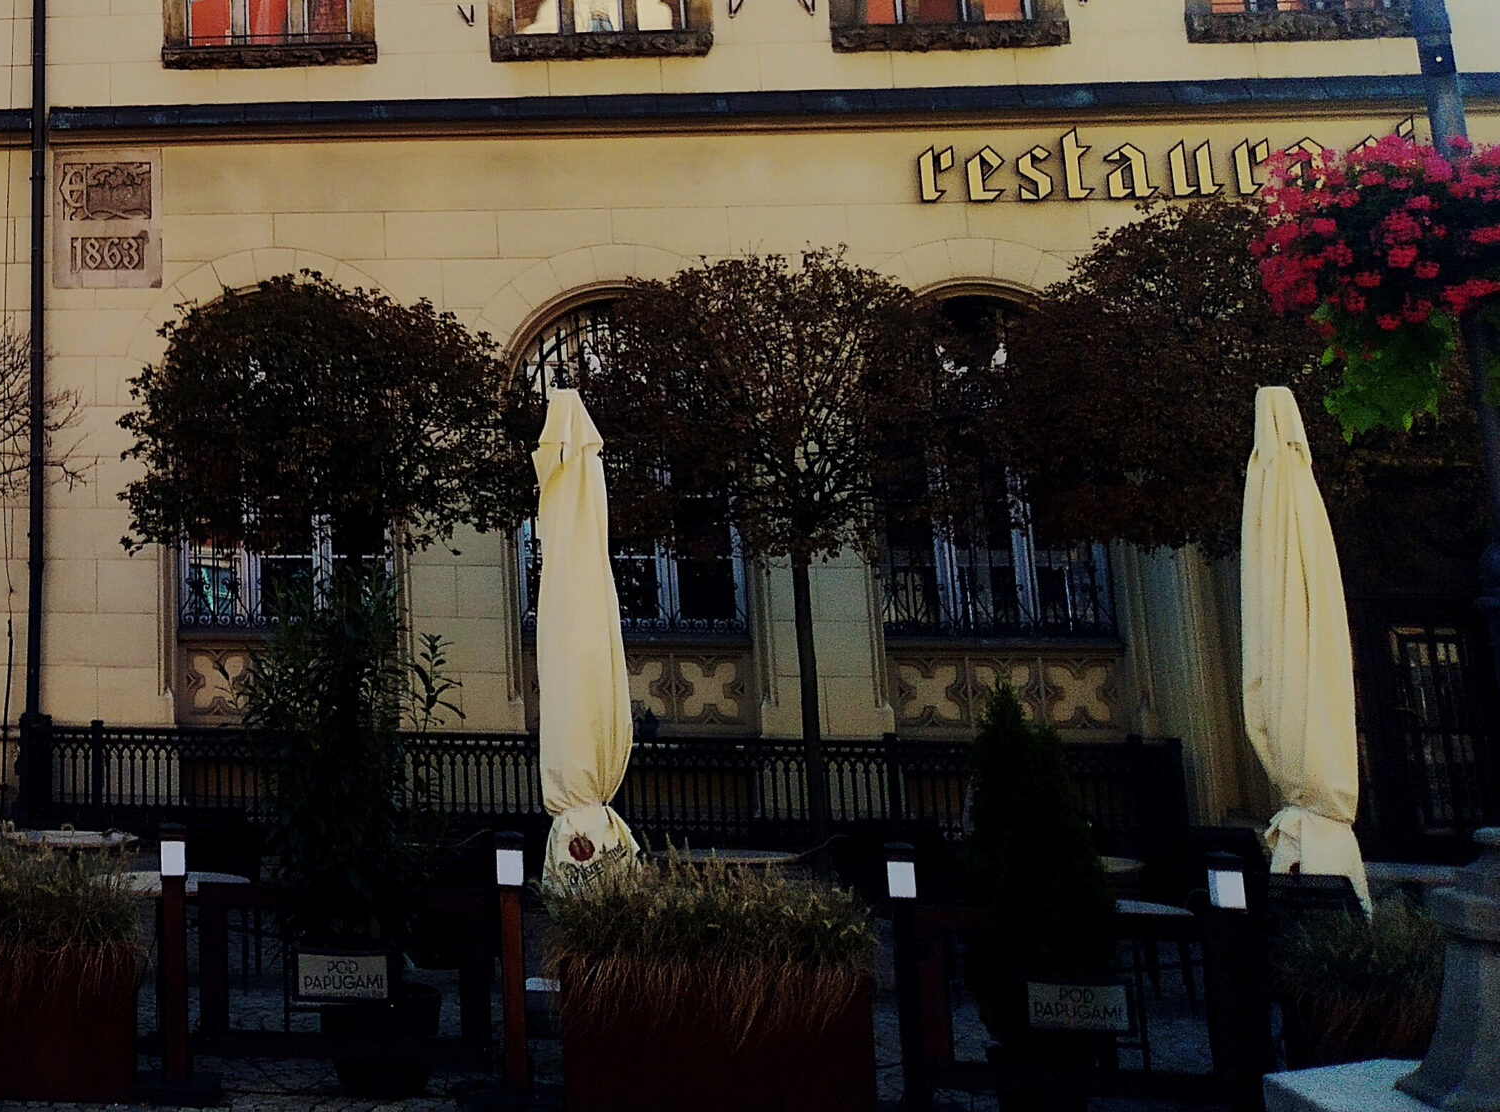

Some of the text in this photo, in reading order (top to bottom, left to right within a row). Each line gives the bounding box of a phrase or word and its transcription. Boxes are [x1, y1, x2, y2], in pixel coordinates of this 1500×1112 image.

[71, 238, 140, 271] 1863
[327, 960, 359, 974] POD
[304, 974, 384, 990] PAPUGAMI
[1059, 988, 1094, 1004] POD
[1035, 1001, 1124, 1019] PAPUGAMI
